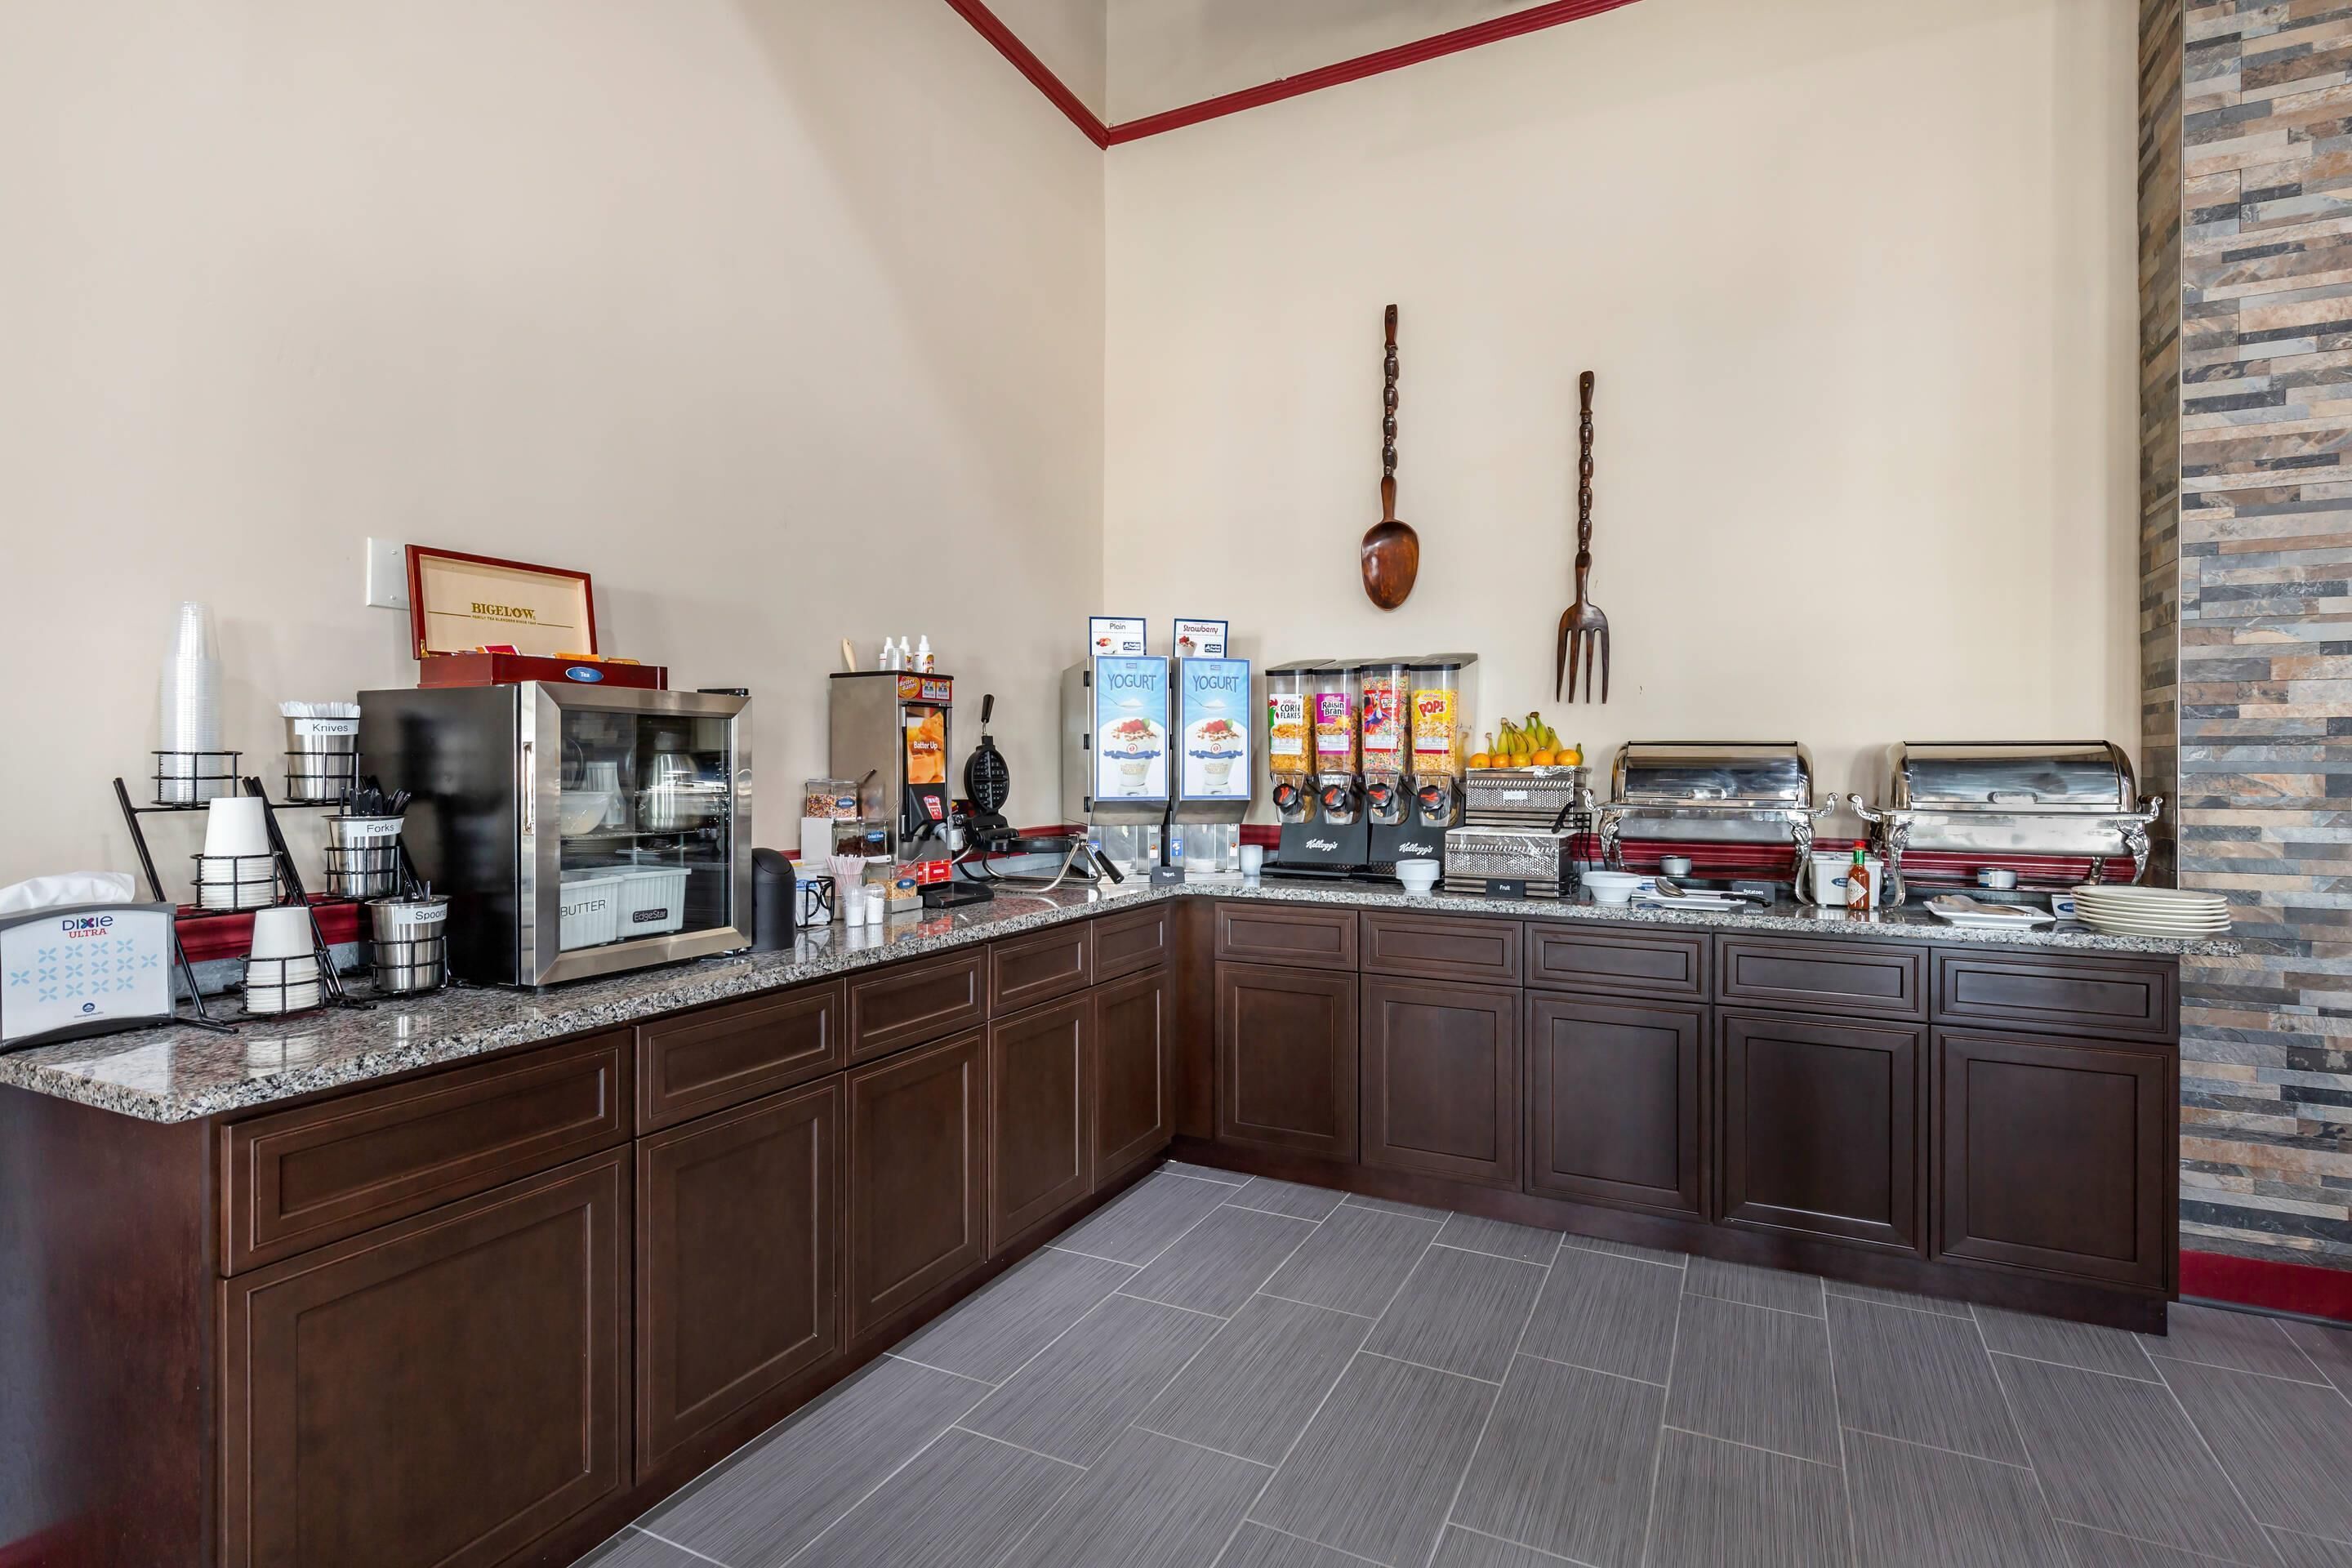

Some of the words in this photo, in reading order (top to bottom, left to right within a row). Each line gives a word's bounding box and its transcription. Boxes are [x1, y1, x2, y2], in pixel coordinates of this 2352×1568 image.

[471, 603, 535, 620] BIGELOW
[1183, 625, 1218, 635] Strawberry
[1107, 674, 1157, 692] YOGURT
[1192, 675, 1239, 693] YOGURT
[1280, 704, 1301, 712] CORN
[1418, 700, 1444, 717] POPS
[313, 724, 349, 732] Knives
[913, 741, 929, 749] Batter
[929, 741, 938, 751] Up
[367, 824, 394, 833] Forks
[1306, 839, 1339, 852] Kellogg's
[1399, 842, 1433, 856] Kellogg's
[560, 899, 606, 916] BUTTER
[634, 910, 666, 921] EdgeStar
[69, 928, 107, 938] ULTRA
